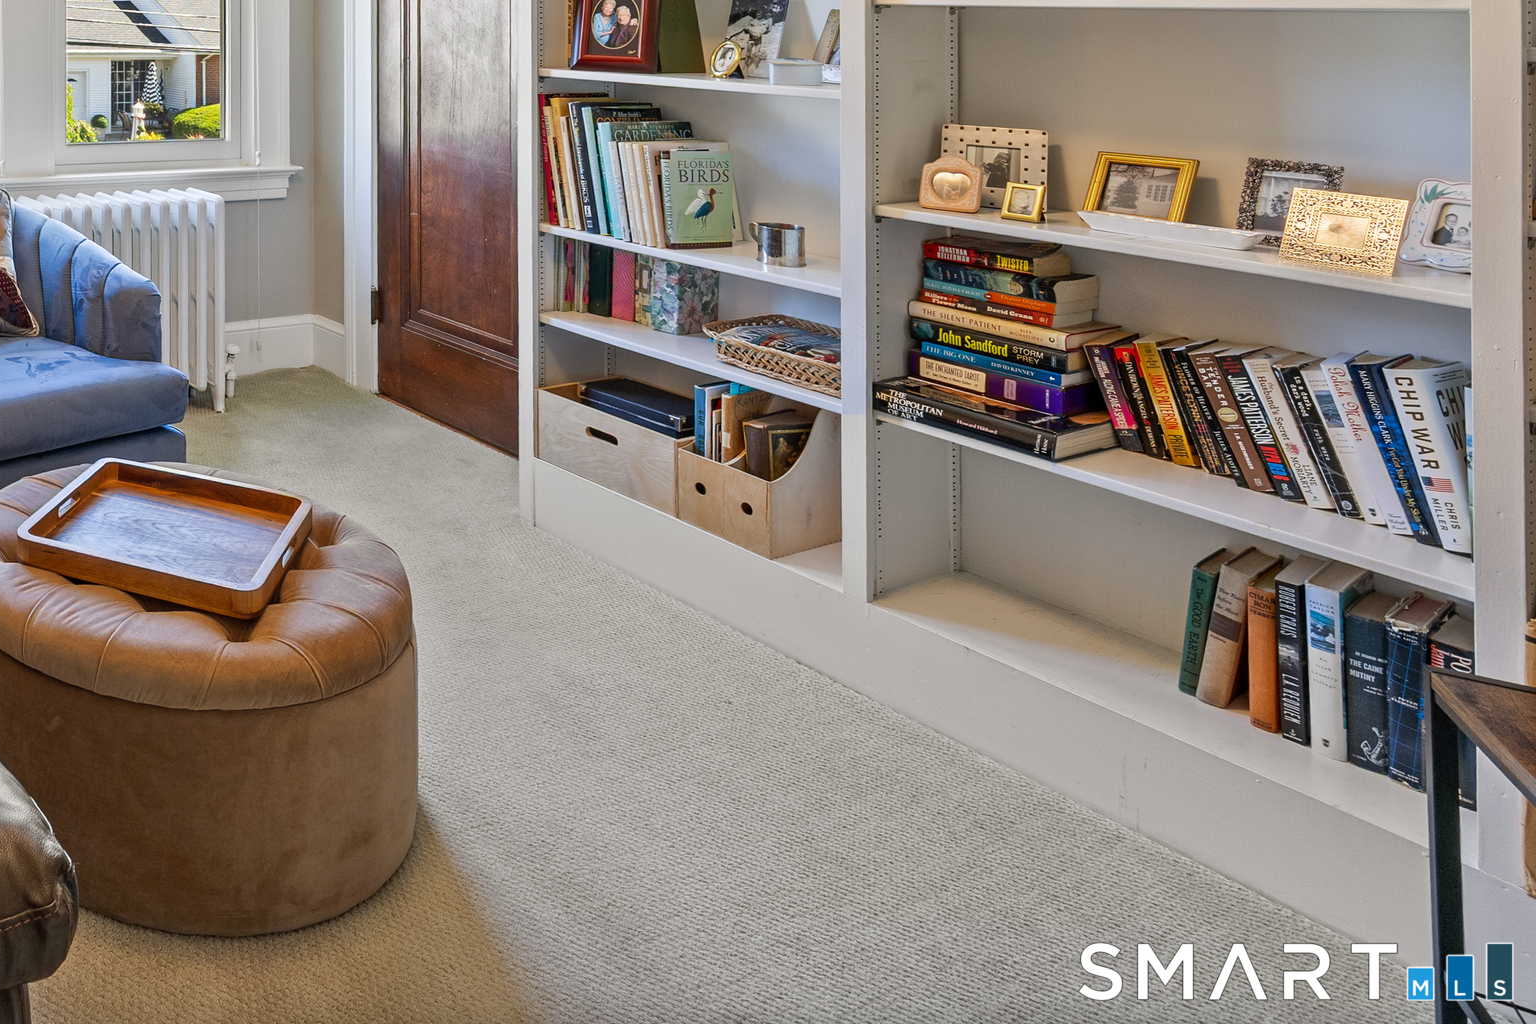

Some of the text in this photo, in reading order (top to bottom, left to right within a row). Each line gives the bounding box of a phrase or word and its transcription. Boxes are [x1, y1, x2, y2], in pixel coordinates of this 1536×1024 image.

[614, 130, 693, 141] GARDENING
[678, 160, 729, 169] FLORIDA'S
[663, 161, 672, 204] FLORIDA'S
[679, 169, 729, 183] BIRDS
[937, 251, 970, 263] KELLERMAN
[938, 245, 968, 256] JONATHAN
[996, 254, 1029, 272] TWISTED
[924, 292, 948, 301] Killers
[943, 284, 981, 297] HONEYMAN
[932, 298, 977, 312] Flower Moon
[986, 306, 1034, 321] David Grann
[922, 308, 1002, 331] THE SILENT PATIENT
[937, 328, 1008, 357] John Sandford
[925, 345, 976, 363] THE BIG ONE
[1012, 346, 1044, 359] STORM
[1016, 354, 1040, 365] PREY
[925, 361, 980, 382] THE ENCHANTED TAROT
[991, 361, 1035, 376] DAVID KINNEY
[1213, 367, 1222, 380] THE
[1148, 373, 1164, 394] JAMES
[1198, 368, 1212, 388] BAR
[1207, 366, 1229, 407] TENDER
[1358, 369, 1373, 391] MARY
[889, 389, 907, 399] THE
[1174, 364, 1201, 422] VINCE FLYNN
[875, 391, 944, 417] METROPOLITAN
[887, 402, 924, 418] MUSEUM
[1155, 395, 1179, 430] PATTERSON
[1228, 375, 1248, 401] JAMES
[1241, 401, 1275, 445] PATTERSON
[1257, 376, 1279, 416] Husband's
[1275, 416, 1290, 441] Secret
[1328, 367, 1367, 443] Polish Mother
[1365, 391, 1383, 420] HIGGINS
[887, 408, 919, 421] OF ART
[1395, 376, 1440, 470] CHIP WAR
[956, 419, 998, 435] Howard Hibbard
[1377, 421, 1392, 445] CLARK
[1168, 435, 1189, 459] PRIVATE
[1313, 428, 1331, 461] ruth ware
[1261, 446, 1282, 464] NYPD
[1267, 462, 1288, 476] RED
[1290, 456, 1312, 494] MORIARTY
[1302, 464, 1318, 486] LIANE
[1400, 480, 1411, 497] Under
[1411, 508, 1421, 522] Skin
[1431, 497, 1449, 531] MILLER
[1444, 502, 1461, 530] CHRIS
[1216, 595, 1232, 605] before
[1216, 602, 1238, 616] the Mast
[1253, 600, 1271, 610] RON
[1309, 600, 1334, 610] PATRICK
[1309, 604, 1335, 614] TAYLOR
[1278, 585, 1297, 638] ROBERT CRAIS
[1186, 588, 1204, 665] The GOOD EARTH
[1349, 658, 1384, 674] THE CAINE
[1350, 669, 1375, 682] MUTINY
[1282, 687, 1300, 724] REQUIEM
